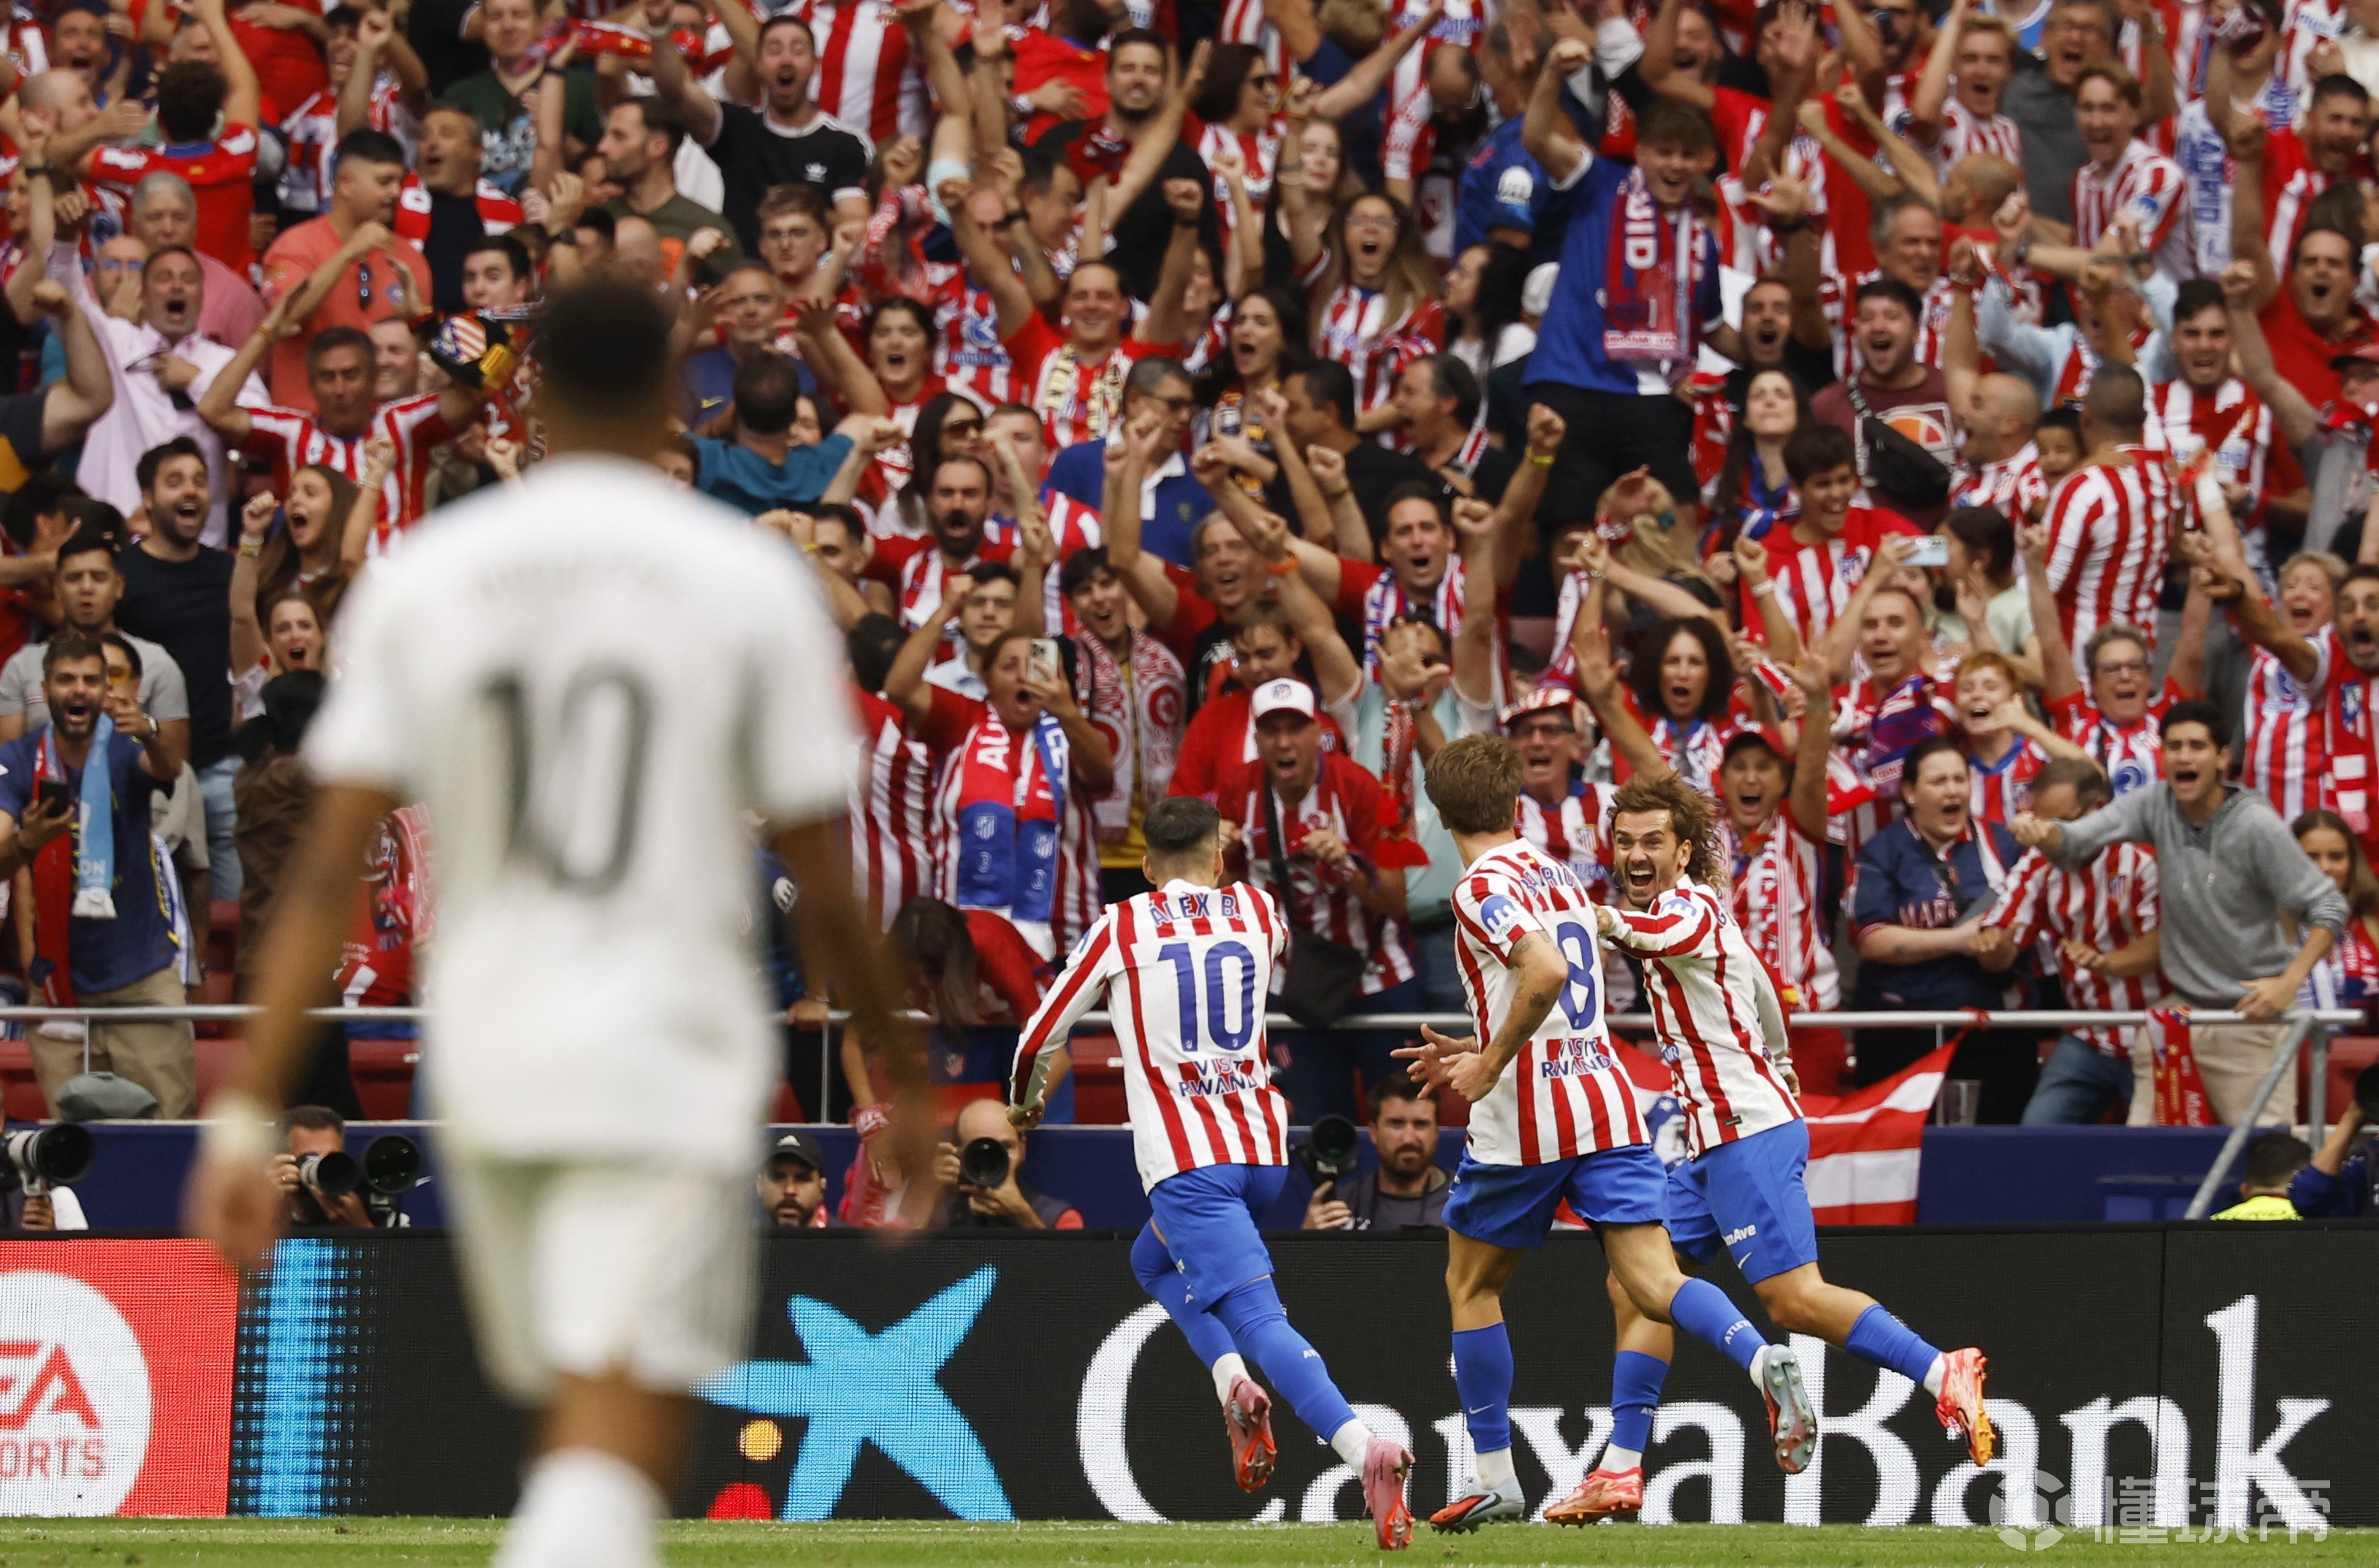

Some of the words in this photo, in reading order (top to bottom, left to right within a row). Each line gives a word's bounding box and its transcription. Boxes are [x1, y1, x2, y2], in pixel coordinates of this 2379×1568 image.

[475, 652, 652, 899] 10
[1149, 894, 1211, 926] ÁLEX
[1221, 894, 1243, 921] B.
[1556, 922, 1595, 1030] 8
[1157, 940, 1256, 1052] 10
[1559, 1039, 1597, 1057] VISIT
[1193, 1058, 1244, 1076] VIST
[1542, 1054, 1613, 1078] RWAND
[1179, 1075, 1258, 1097] RWAND
